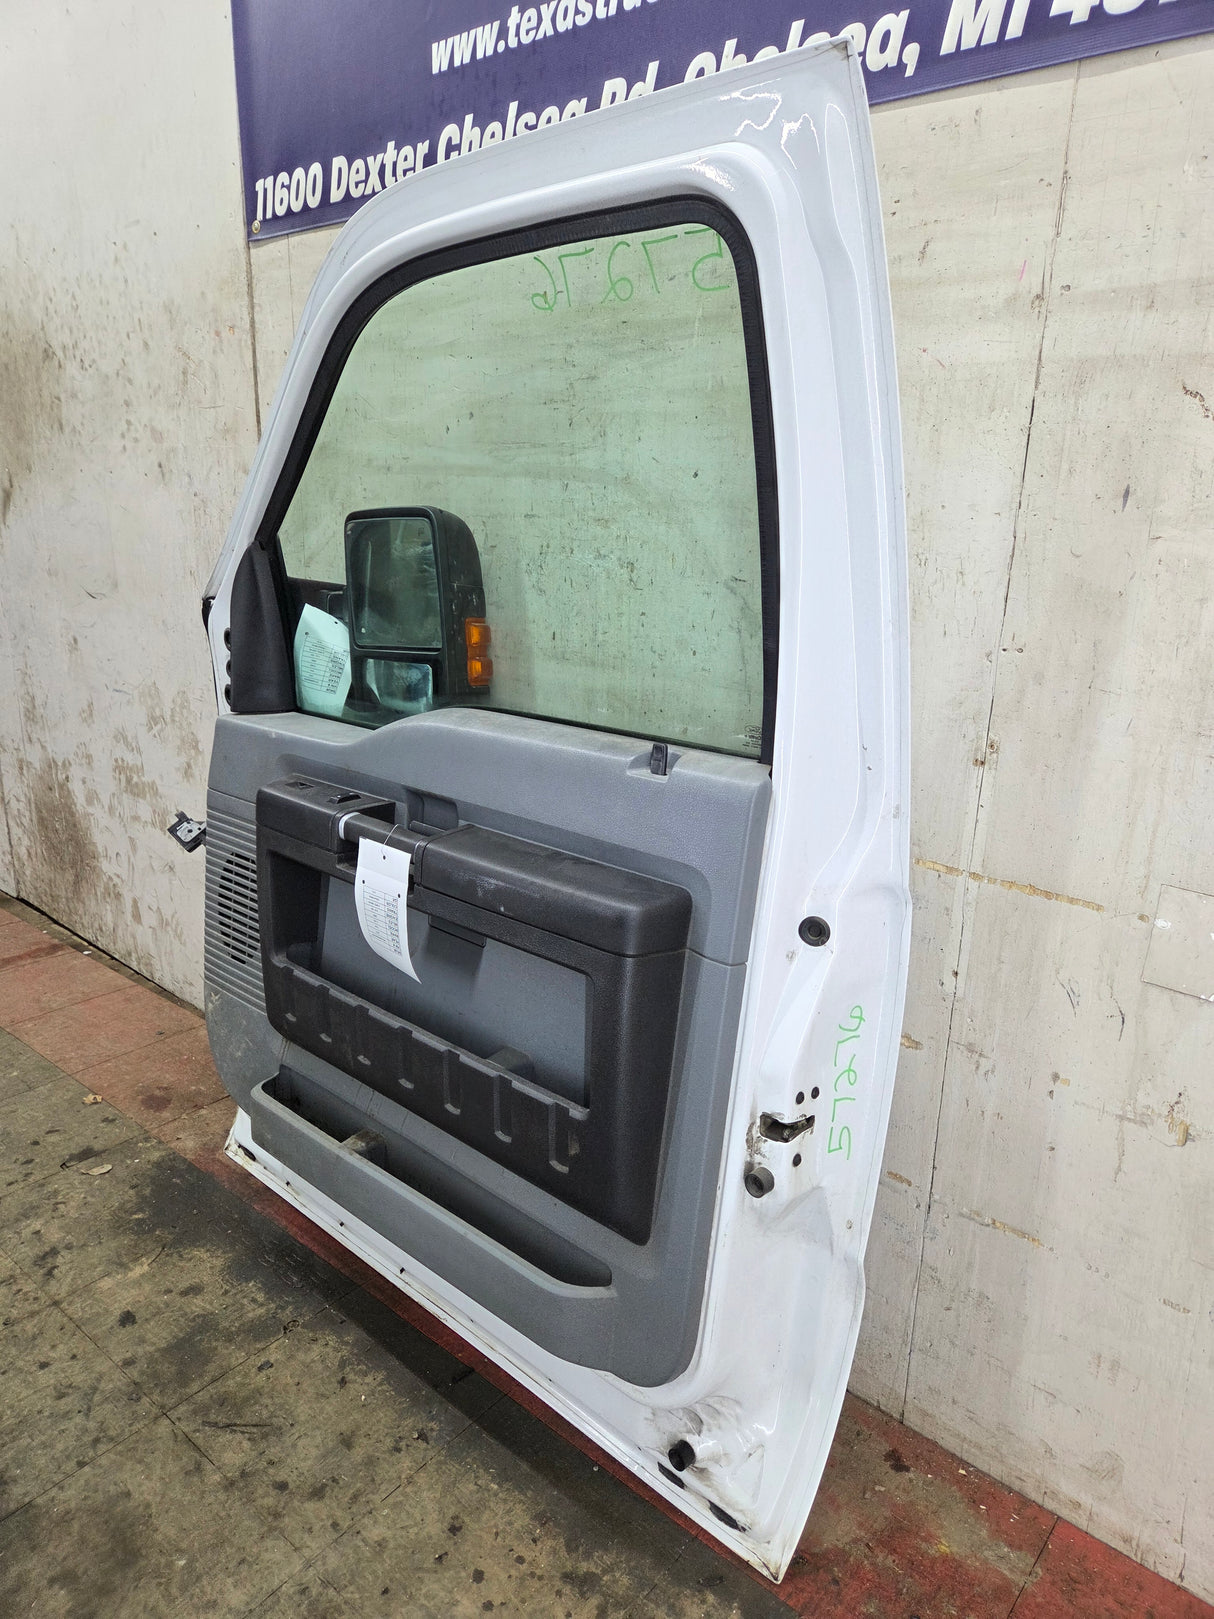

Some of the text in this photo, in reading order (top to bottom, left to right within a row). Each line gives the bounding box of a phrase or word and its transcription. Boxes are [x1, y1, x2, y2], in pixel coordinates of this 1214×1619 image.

[255, 161, 323, 221] 11600
[330, 140, 430, 203] Dexter
[828, 1005, 866, 1160] 57276
